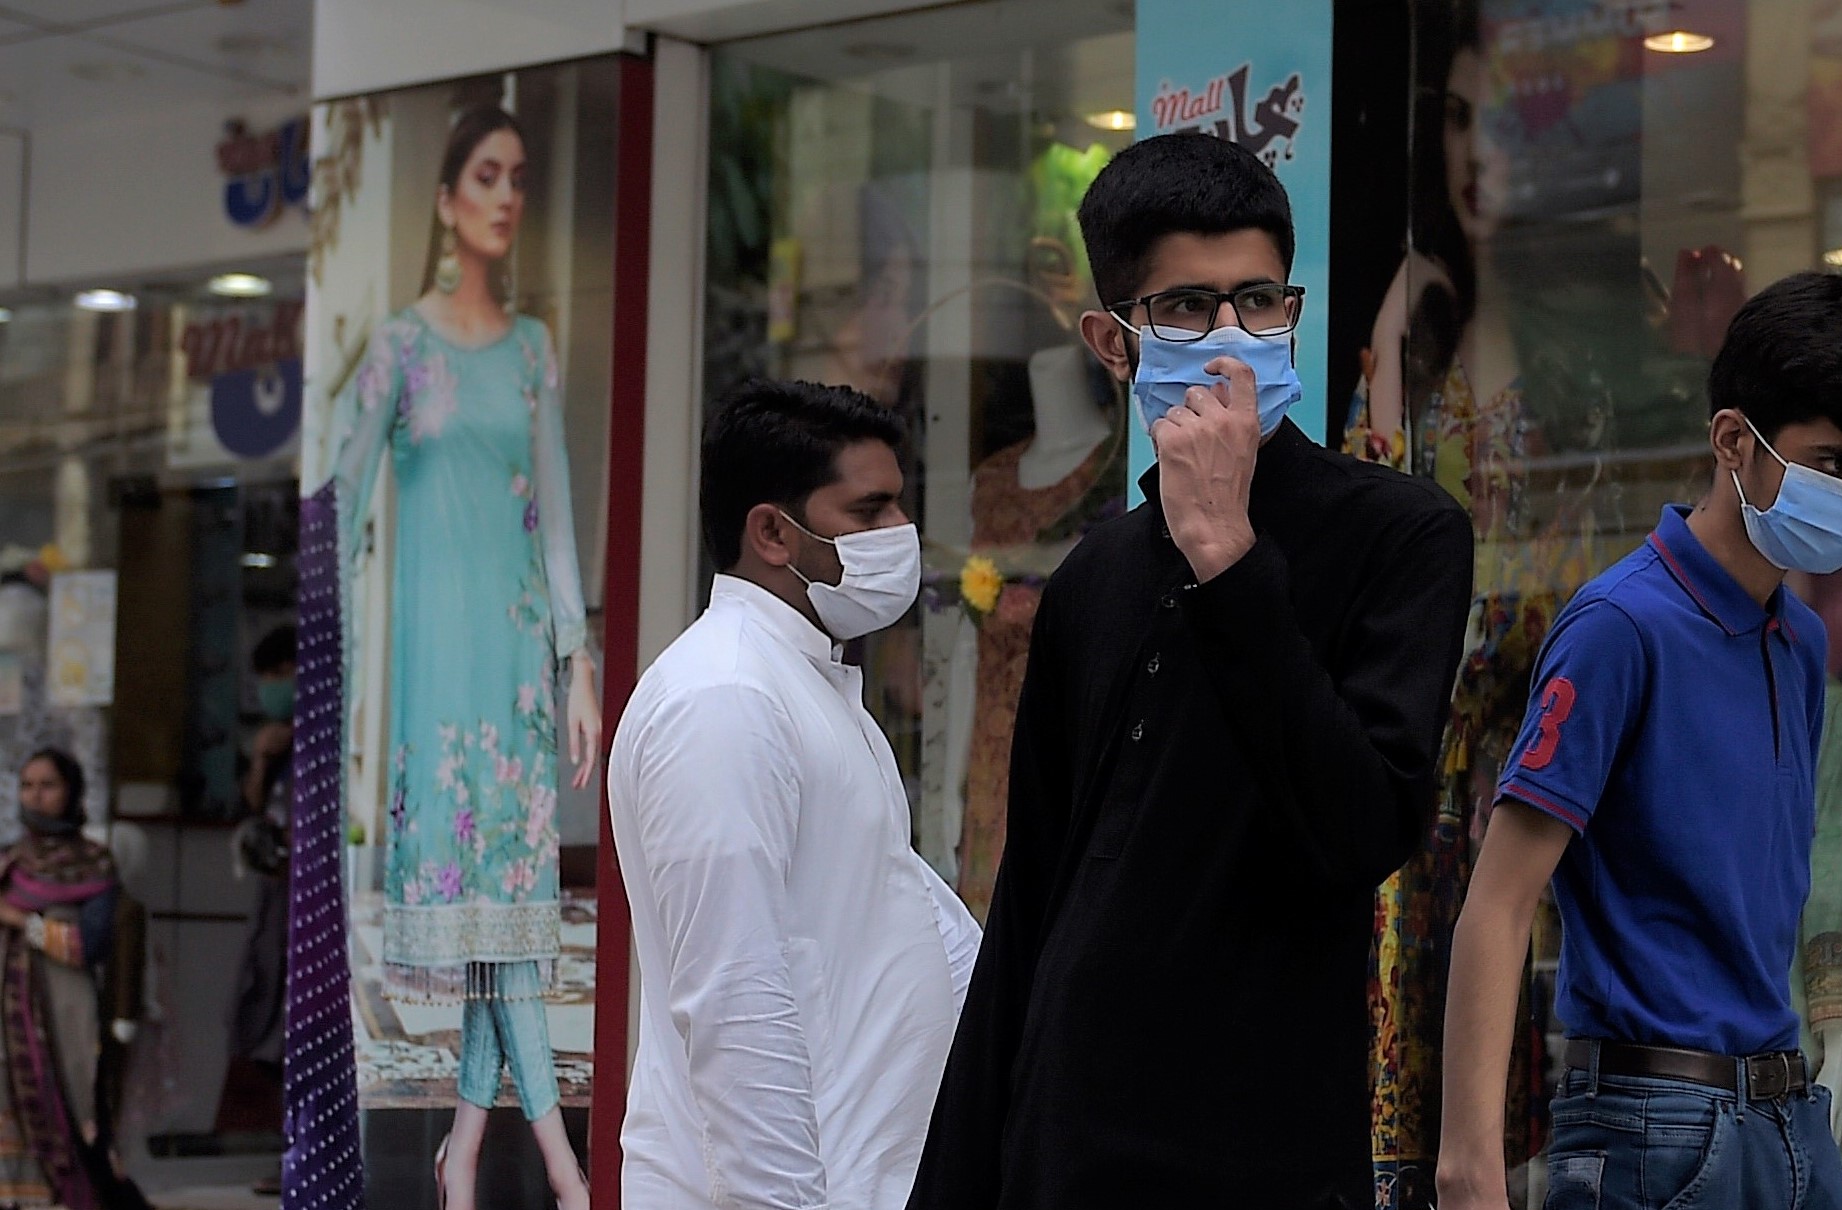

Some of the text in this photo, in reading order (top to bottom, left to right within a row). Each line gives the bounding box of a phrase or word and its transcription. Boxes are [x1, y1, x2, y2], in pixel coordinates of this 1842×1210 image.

[1153, 79, 1224, 129] Mall
[1176, 64, 1304, 169] پہچا
[1519, 676, 1577, 771] 3
